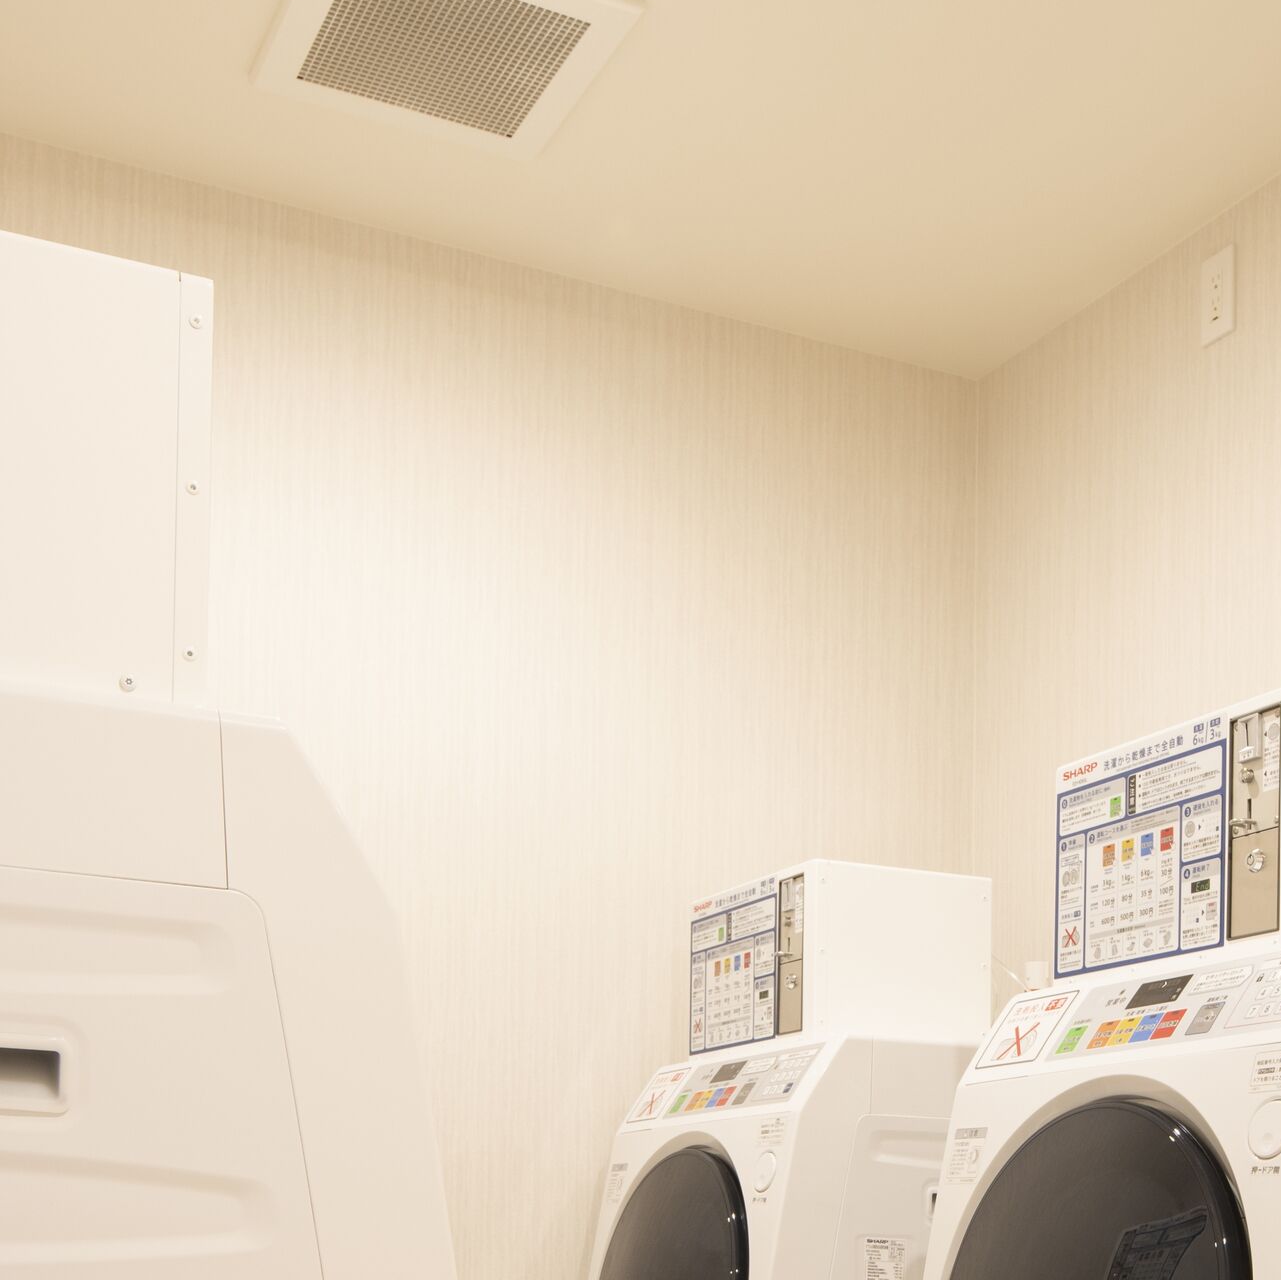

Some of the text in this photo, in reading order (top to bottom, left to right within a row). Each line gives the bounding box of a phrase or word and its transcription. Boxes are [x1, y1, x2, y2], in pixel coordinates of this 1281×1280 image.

[1103, 735, 1184, 771] 洗濯から乾燥まで全自動
[1062, 761, 1099, 782] SHARP
